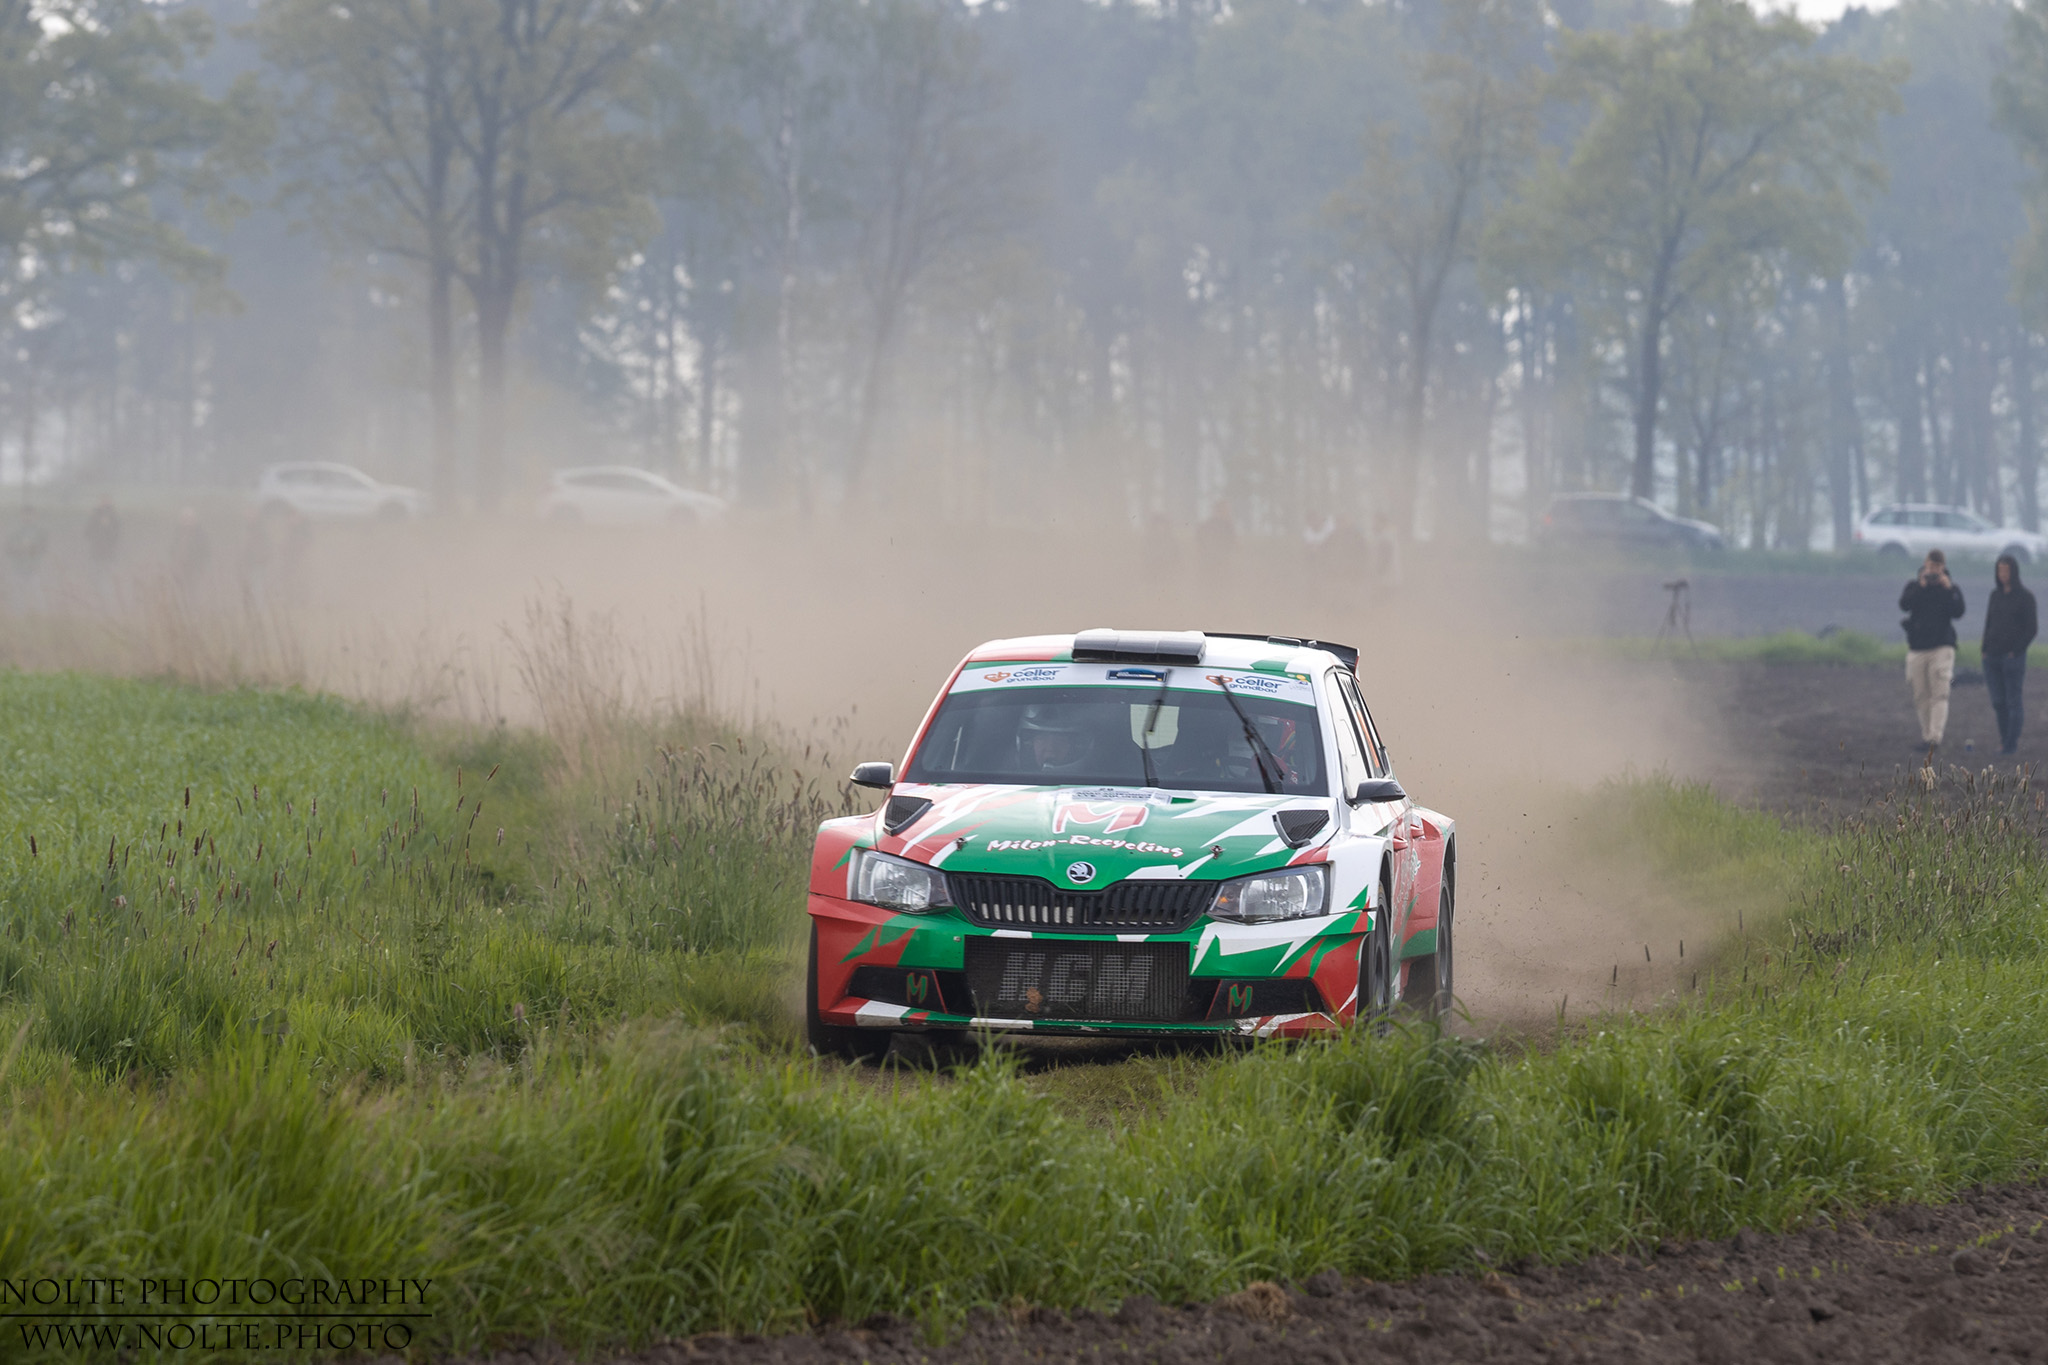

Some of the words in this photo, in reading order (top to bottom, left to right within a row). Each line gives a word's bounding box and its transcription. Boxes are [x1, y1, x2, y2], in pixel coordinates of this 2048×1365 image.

[1013, 669, 1060, 678] celler
[1006, 676, 1056, 684] grundbau
[1235, 677, 1282, 690] celler
[1229, 683, 1278, 694] grundbau
[1052, 802, 1150, 835] M
